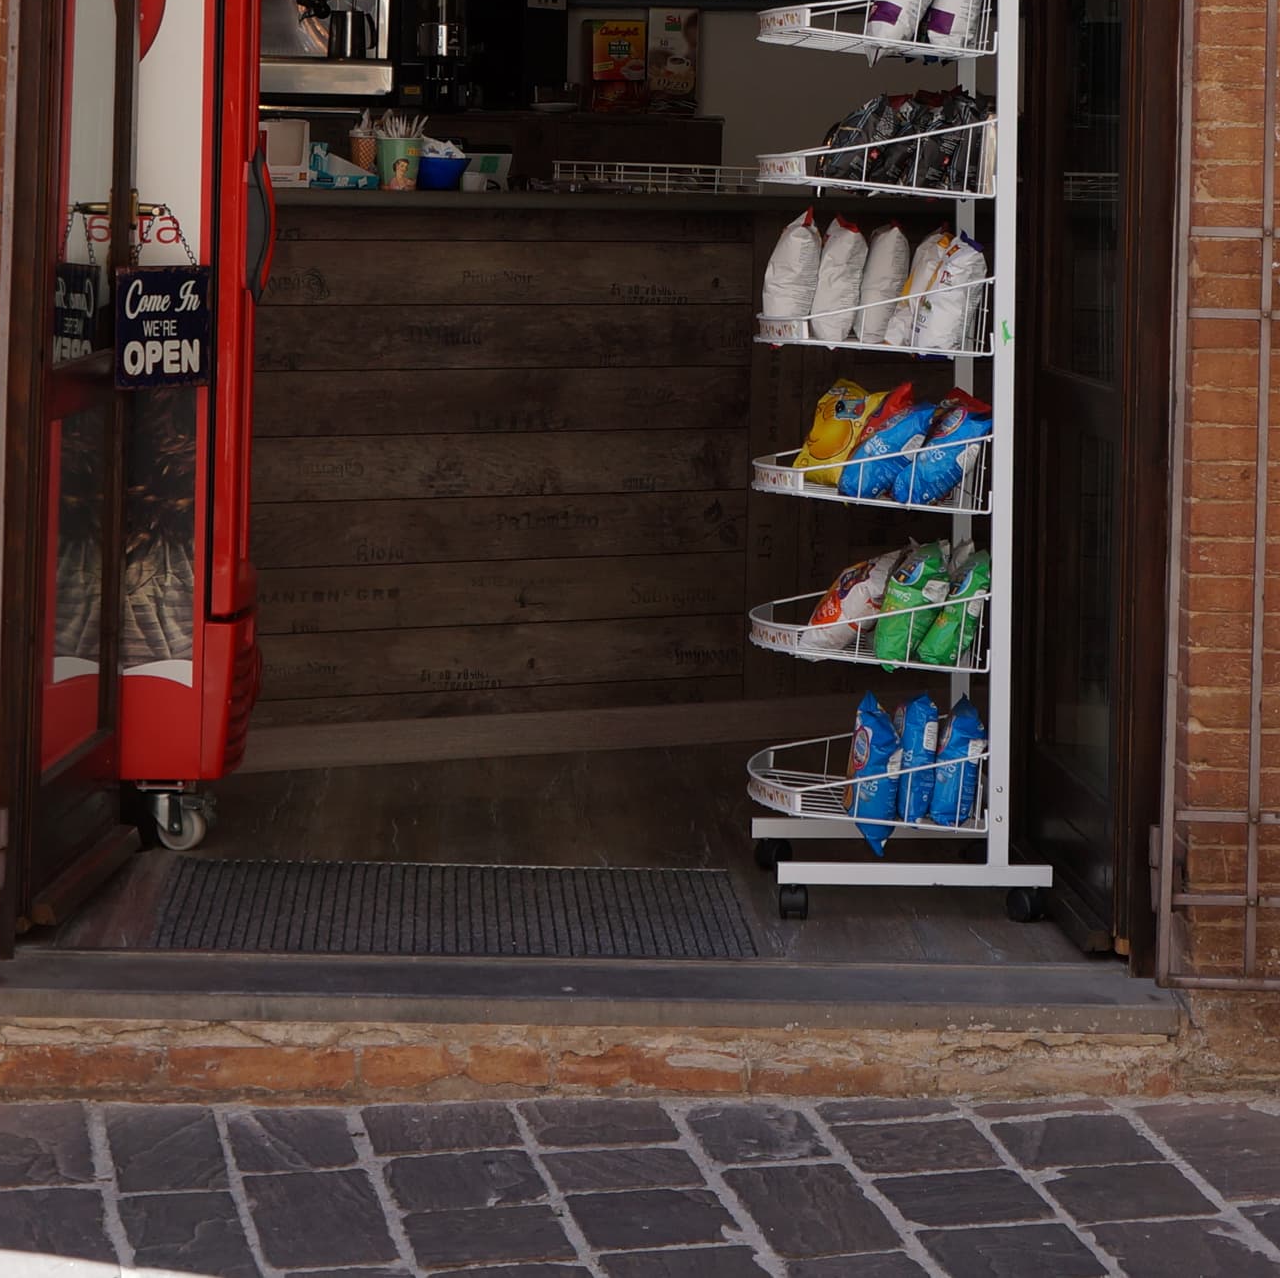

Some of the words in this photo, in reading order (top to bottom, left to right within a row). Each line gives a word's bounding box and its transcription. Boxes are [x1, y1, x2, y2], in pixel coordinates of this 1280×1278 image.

[125, 279, 170, 319] Come
[175, 280, 200, 312] In
[143, 320, 177, 337] WE'RE
[124, 339, 200, 376] OPEN
